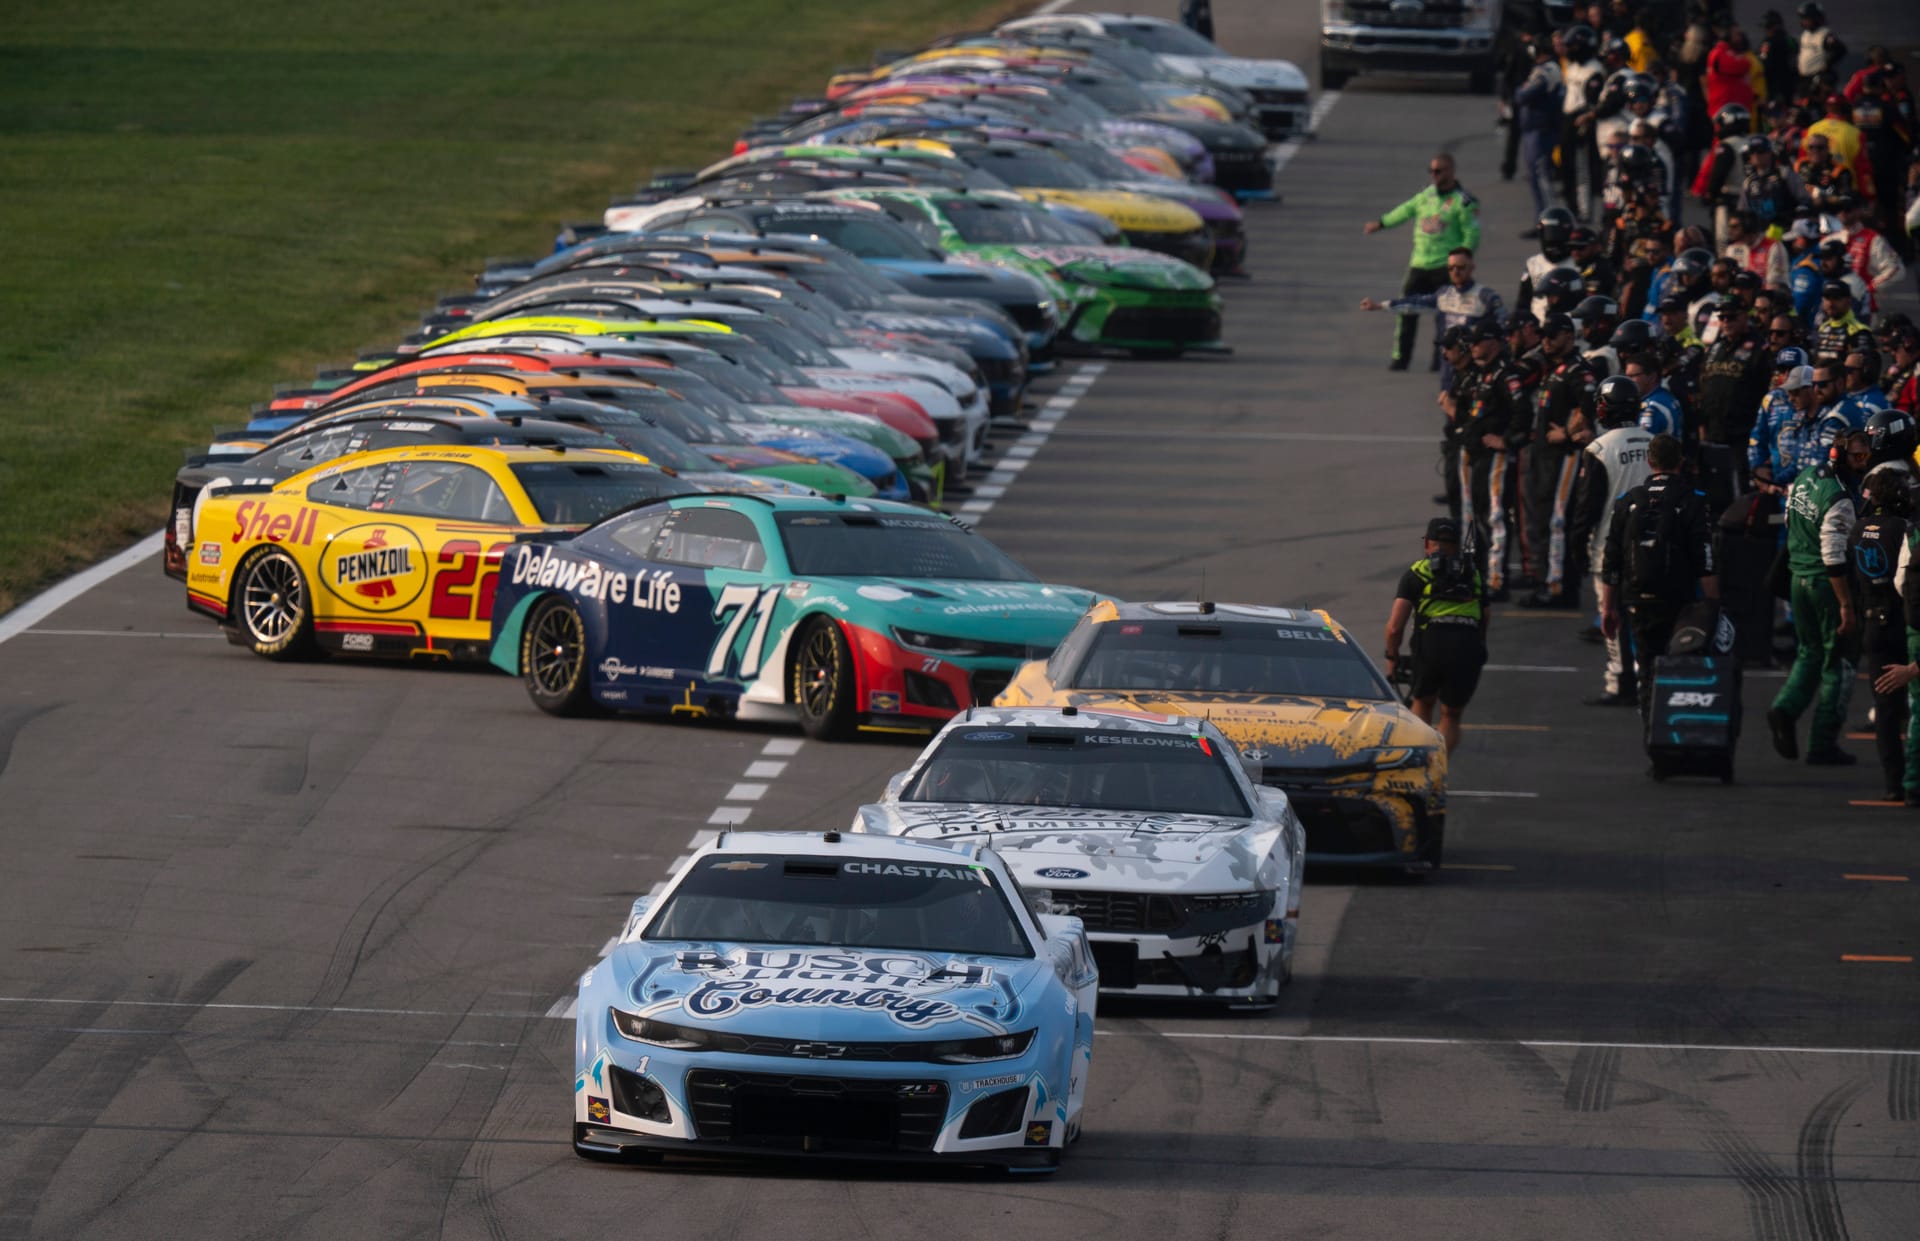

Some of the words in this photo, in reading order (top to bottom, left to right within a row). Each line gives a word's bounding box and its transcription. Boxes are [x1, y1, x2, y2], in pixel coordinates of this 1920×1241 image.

[1619, 448, 1651, 465] OFFI
[232, 500, 319, 546] Shell
[881, 518, 954, 530] MCDOWE
[337, 545, 413, 585] PENNZOIL
[512, 545, 627, 604] Delaware
[633, 569, 681, 613] Life
[343, 633, 374, 645] FORD
[705, 582, 784, 682] 71
[1277, 629, 1334, 641] BELL
[921, 658, 941, 672] 71
[1084, 735, 1200, 750] KESELOWSK
[844, 862, 979, 882] CHASTAIN
[674, 951, 992, 986] BUSCH
[743, 969, 912, 988] LIGHT
[688, 981, 958, 1023] Country
[636, 1056, 650, 1073] 1
[976, 1075, 1018, 1088] TRACKHOUSE
[588, 1104, 610, 1117] SUNOCO
